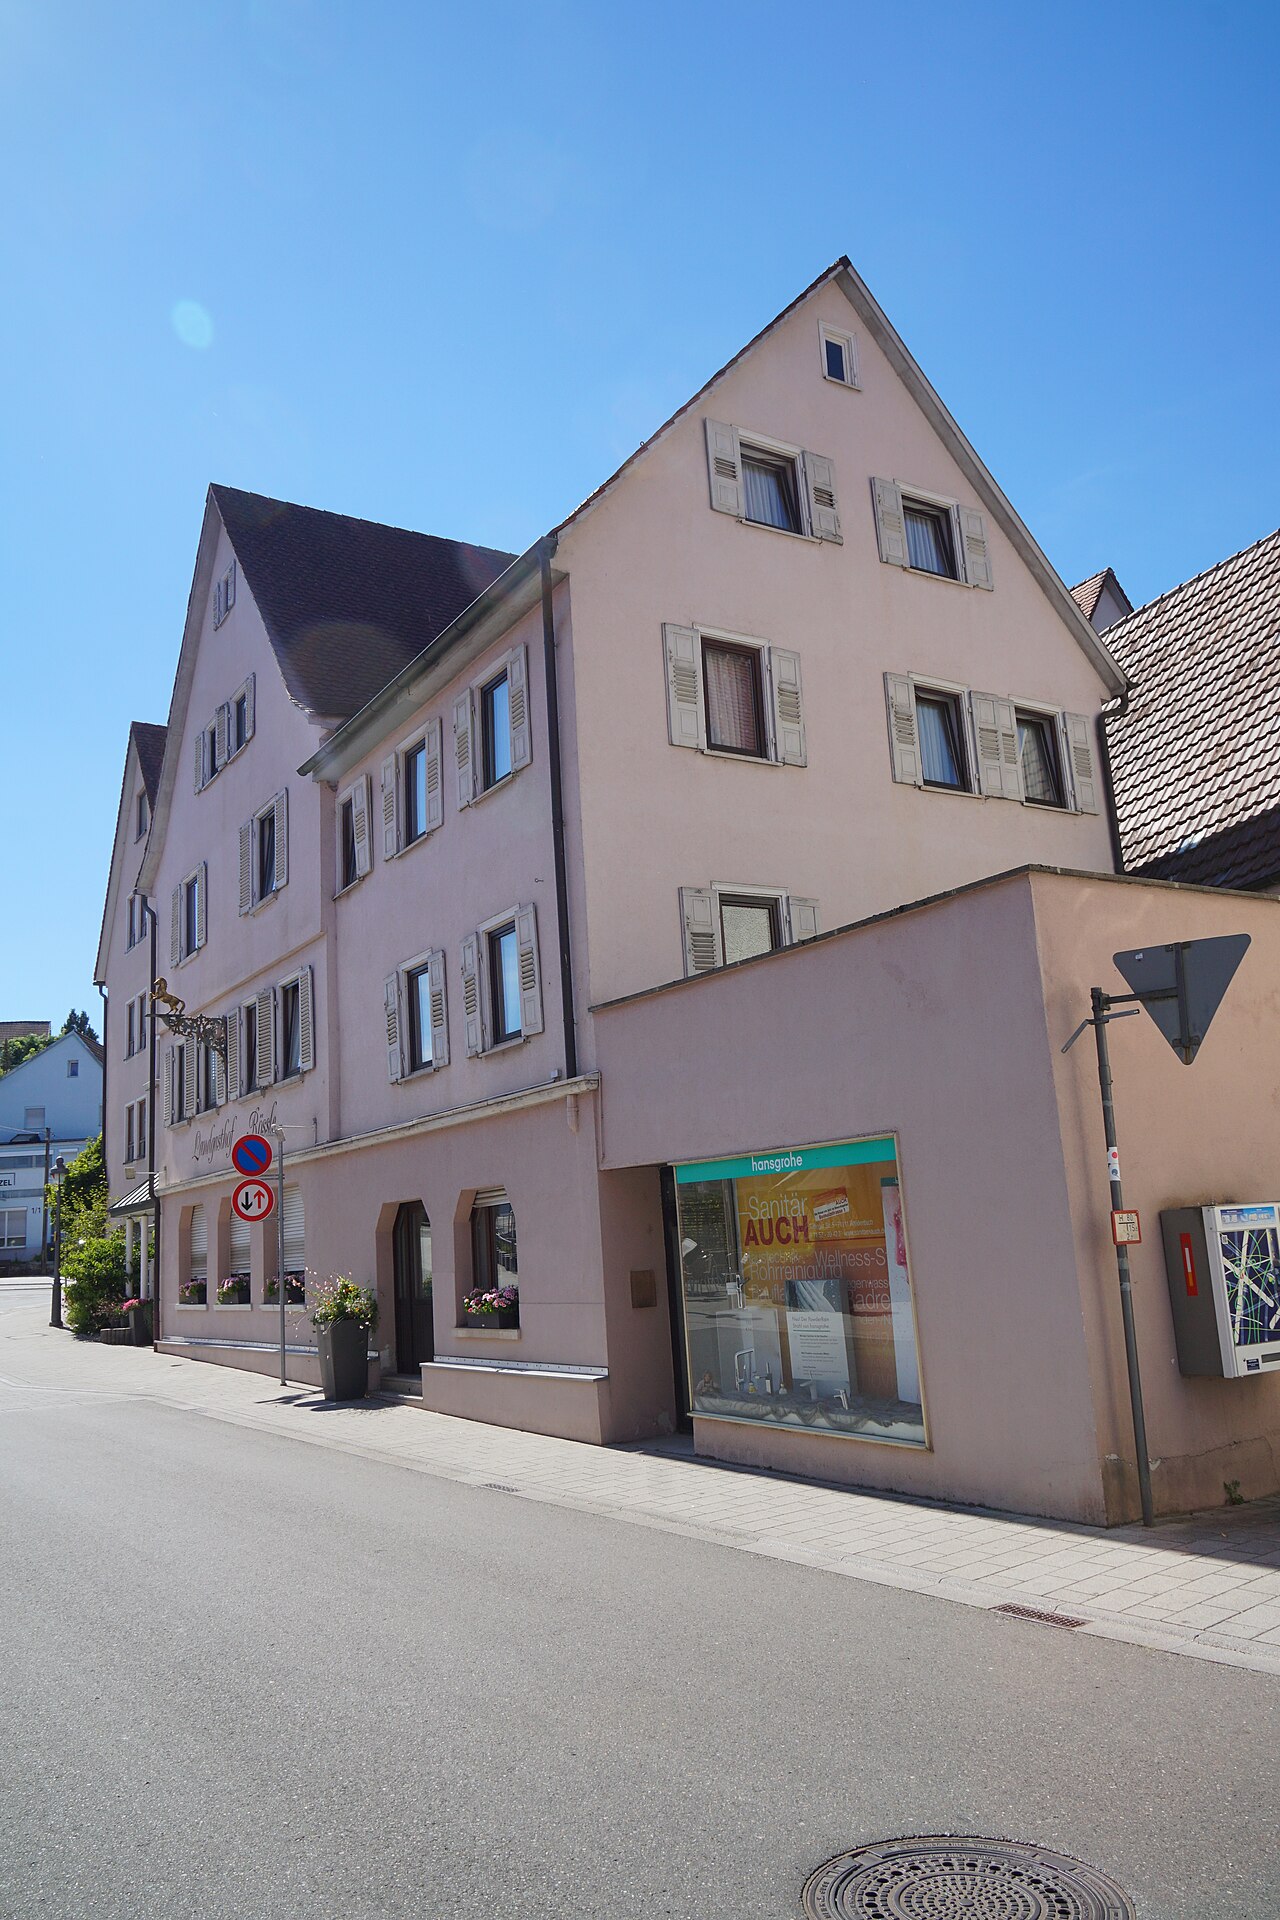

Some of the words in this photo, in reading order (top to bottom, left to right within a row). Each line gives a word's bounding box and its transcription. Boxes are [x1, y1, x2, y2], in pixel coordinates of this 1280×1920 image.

[192, 1116, 237, 1164] Landgasthof
[751, 1151, 803, 1172] hansgrohe
[748, 1192, 808, 1221] Sanitär
[744, 1215, 809, 1246] AUCH
